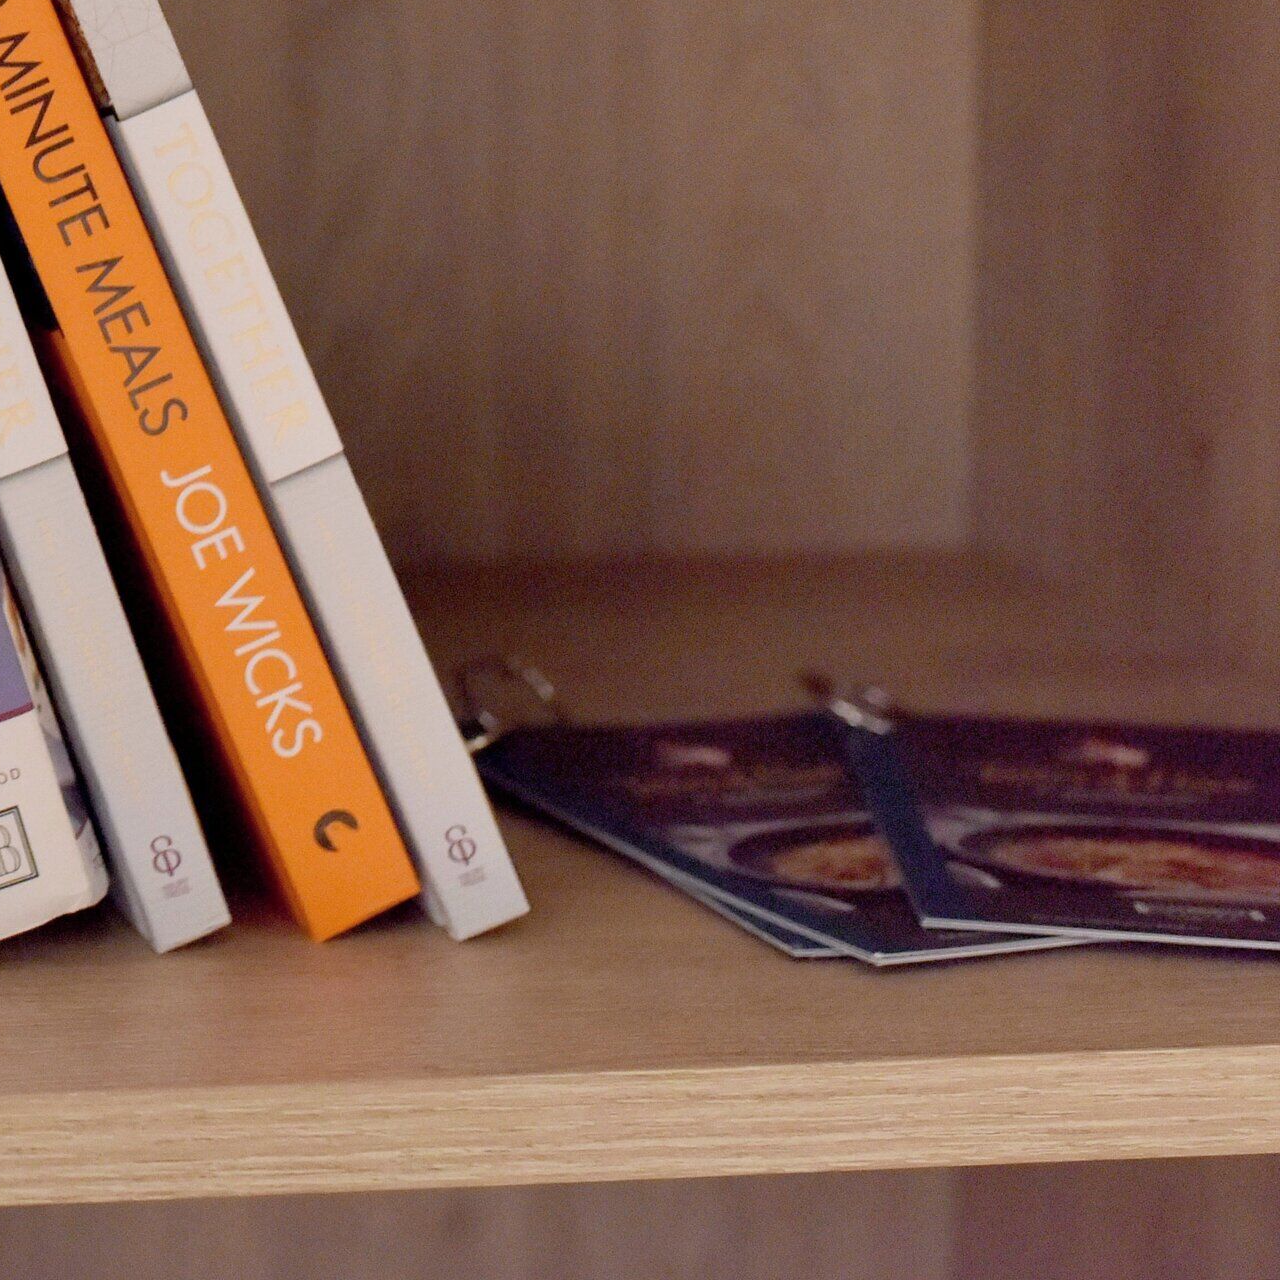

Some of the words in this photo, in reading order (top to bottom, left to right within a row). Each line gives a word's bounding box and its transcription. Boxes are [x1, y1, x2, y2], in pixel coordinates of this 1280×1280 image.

[75, 255, 189, 437] MEALS
[160, 463, 245, 569] JOE
[214, 567, 323, 759] WICKS
